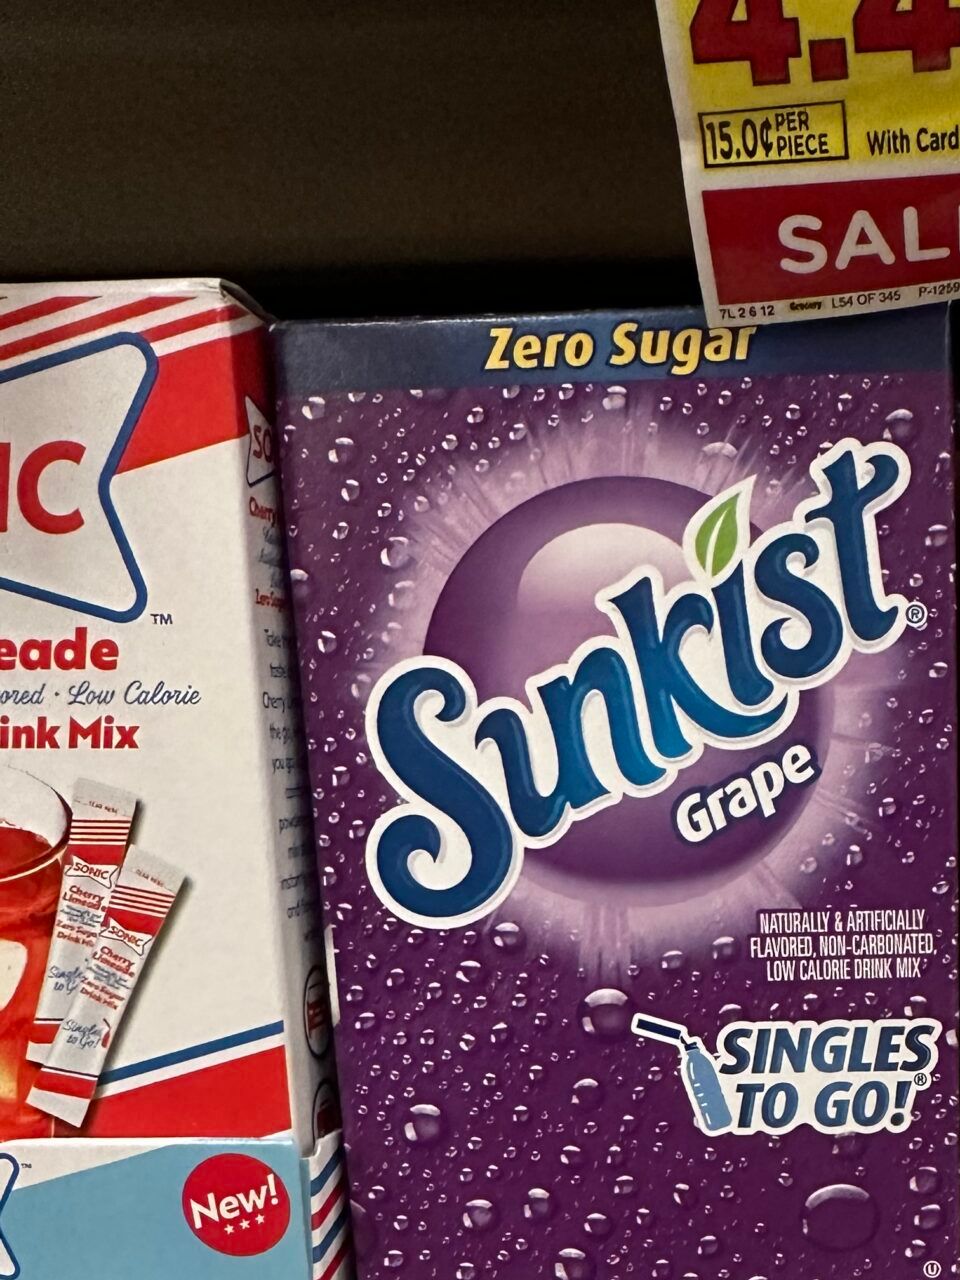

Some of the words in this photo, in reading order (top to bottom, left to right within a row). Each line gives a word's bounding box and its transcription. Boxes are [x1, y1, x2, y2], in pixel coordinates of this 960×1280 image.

[705, 117, 774, 160] 15.0¢
[775, 112, 809, 132] PER
[776, 134, 829, 157] PIECE
[867, 129, 911, 155] With
[916, 125, 960, 152] Card
[484, 326, 593, 370] Zero
[606, 322, 757, 374] Sugar
[67, 681, 114, 704] Low
[123, 680, 201, 706] Calorie
[367, 437, 912, 929] Sunkist
[68, 716, 140, 749] Mix
[676, 745, 818, 843] Grape
[760, 912, 829, 933] NATURALLY
[835, 912, 843, 932] &
[847, 909, 925, 932] ARTIFICIALLY
[750, 936, 816, 957] FLAVORED,
[819, 933, 937, 956] NON-CARBONATED,
[766, 961, 796, 981] LOW
[799, 960, 850, 980] CALORIE
[854, 959, 892, 979] DRINK
[895, 957, 921, 978] MIX
[718, 1024, 935, 1075] SINGLES
[735, 1081, 799, 1128] TO
[813, 1078, 913, 1128] GO!
[190, 1173, 280, 1230] New!
